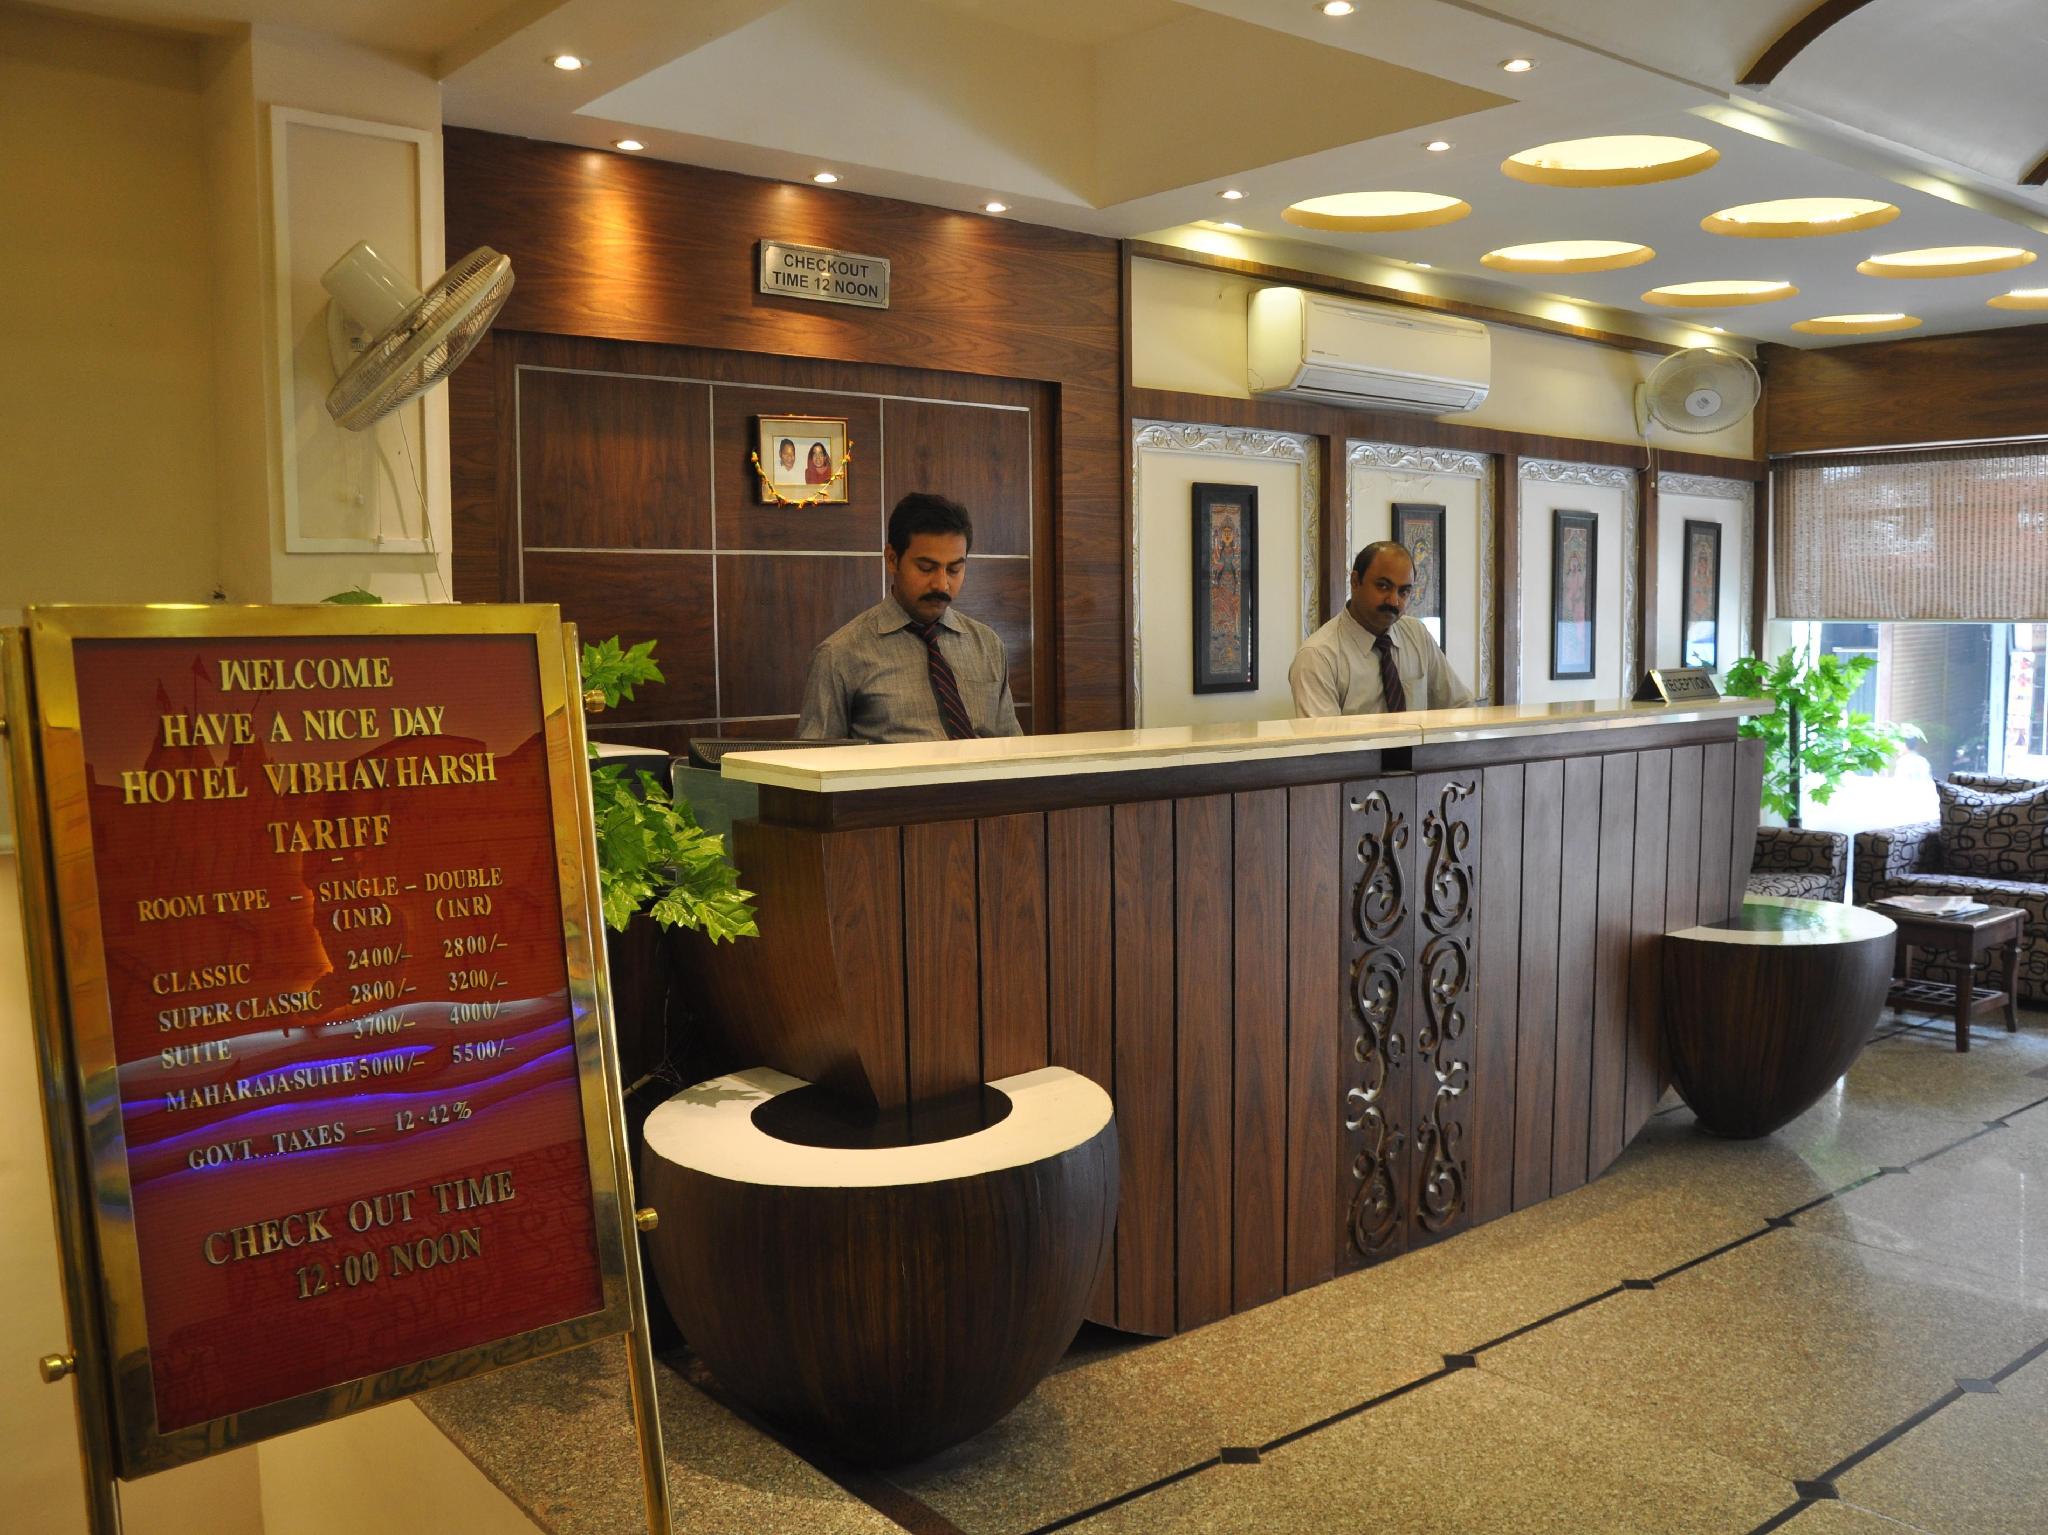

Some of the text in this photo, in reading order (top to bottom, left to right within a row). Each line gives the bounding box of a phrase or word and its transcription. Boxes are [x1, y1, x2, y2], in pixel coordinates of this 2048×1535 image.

[773, 271, 878, 298] TIME 12 NOON
[784, 254, 869, 278] CHECKOUT
[219, 657, 394, 692] WELCOME
[161, 706, 445, 747] HAVE A NICE DAY
[121, 767, 249, 805] HOTEL
[396, 753, 498, 787] HARSH
[268, 815, 391, 854] TARIFF
[138, 894, 207, 922] ROOM
[212, 889, 271, 913] TYPE
[318, 876, 399, 903] SINGLE
[424, 867, 503, 892] DOUBLE
[332, 894, 492, 932] (INR) (INR)
[153, 933, 509, 995] CLASSIC 2400/- 2800/-
[351, 978, 417, 1005] 2800/-
[449, 969, 509, 992] 3200/-
[161, 1039, 232, 1070] SUITE
[450, 1000, 512, 1025] 4000/-
[452, 1039, 516, 1065] 5500/-
[272, 1122, 346, 1154] TAXES
[204, 1170, 516, 1266] CHECK OUT TIME
[391, 1227, 483, 1278] NOON
